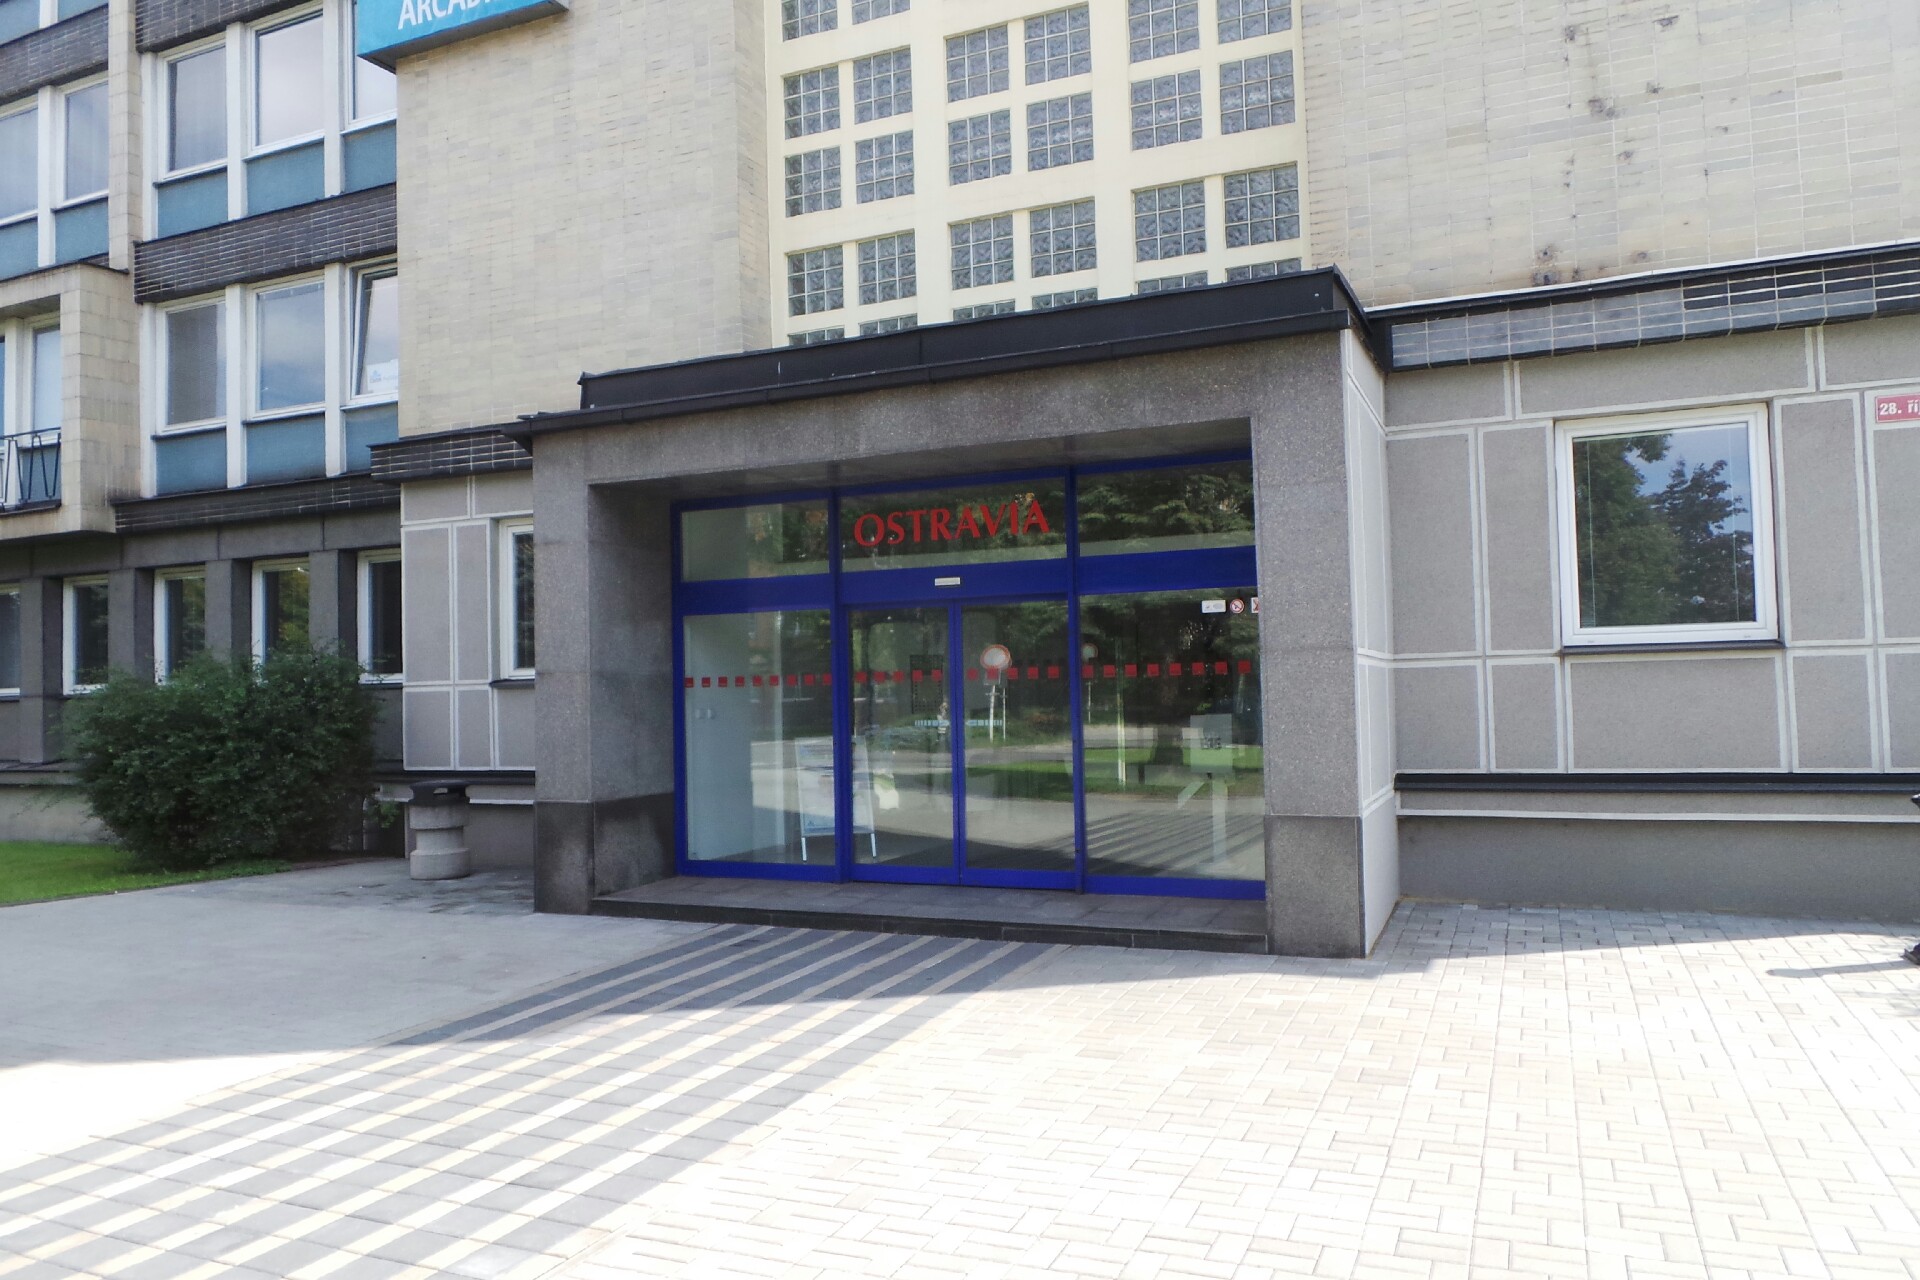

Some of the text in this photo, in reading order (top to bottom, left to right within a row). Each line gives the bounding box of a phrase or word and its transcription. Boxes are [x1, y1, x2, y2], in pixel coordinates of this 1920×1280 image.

[1880, 399, 1920, 415] 28. ří
[853, 499, 1051, 547] OSTRAVIA
